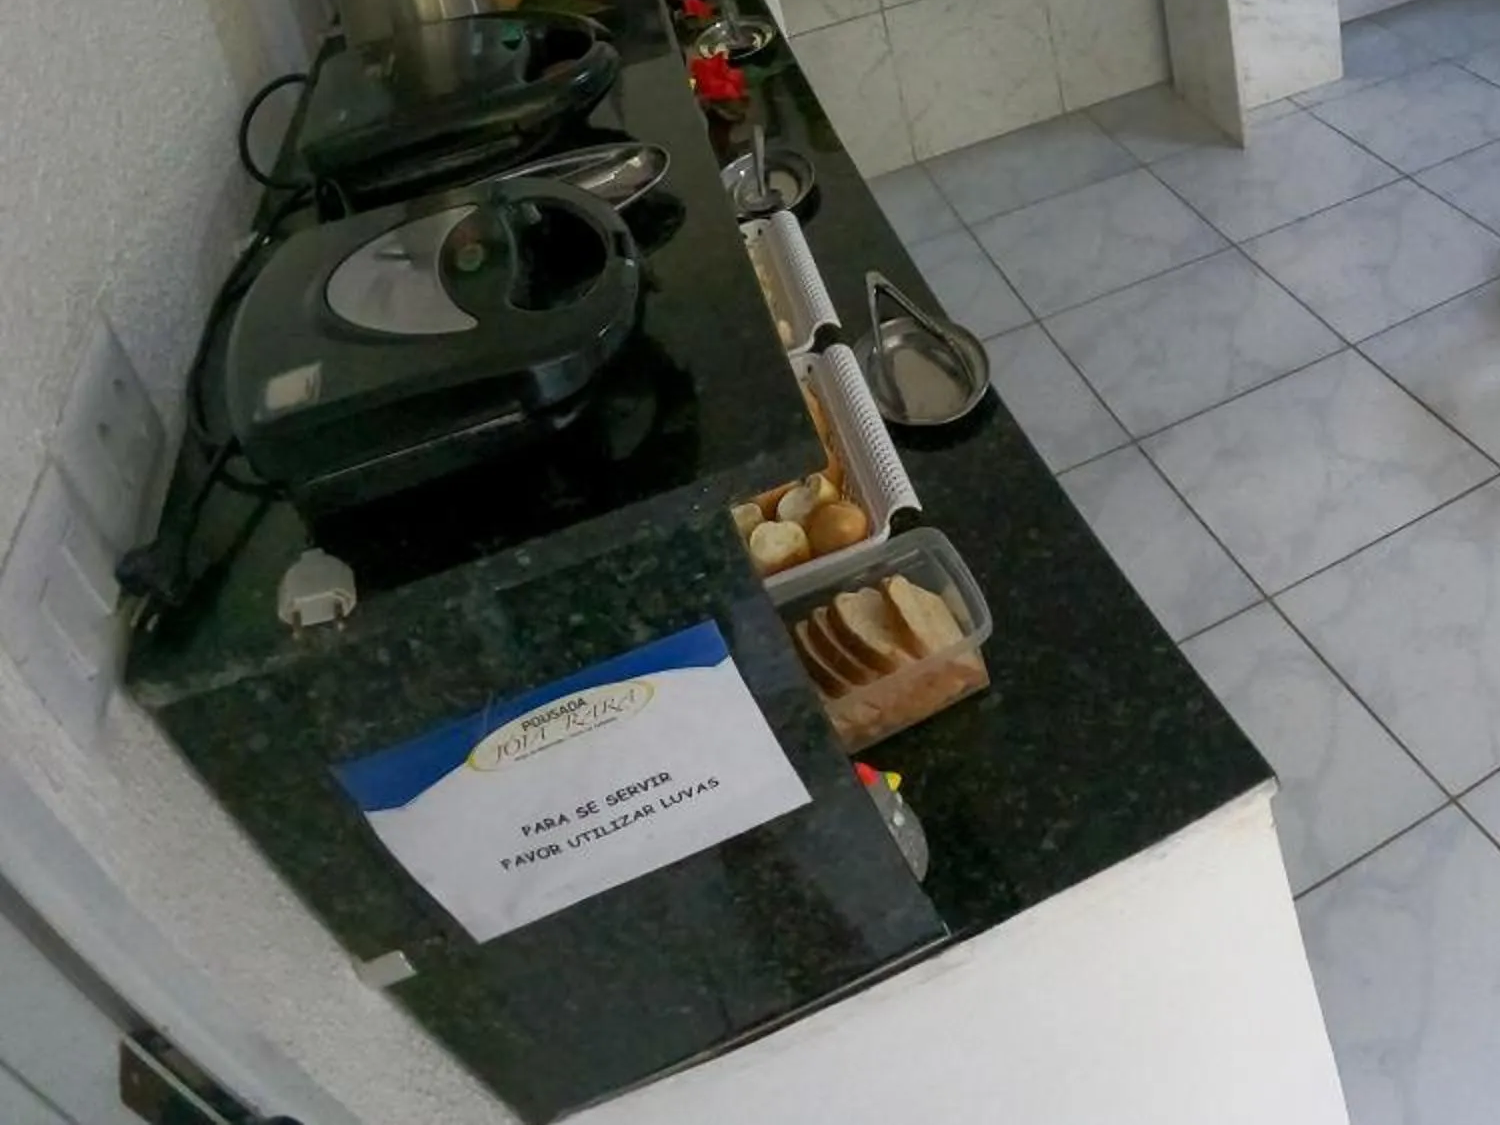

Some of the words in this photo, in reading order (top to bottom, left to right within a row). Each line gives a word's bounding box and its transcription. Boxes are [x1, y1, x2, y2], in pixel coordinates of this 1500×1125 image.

[521, 698, 587, 731] POUSADA
[500, 844, 562, 870] FAVOR
[567, 805, 656, 848] UTILIZAR
[659, 776, 720, 809] LUVAS
[521, 814, 570, 837] PARA
[575, 800, 600, 819] SE
[605, 772, 672, 806] SERVIR
